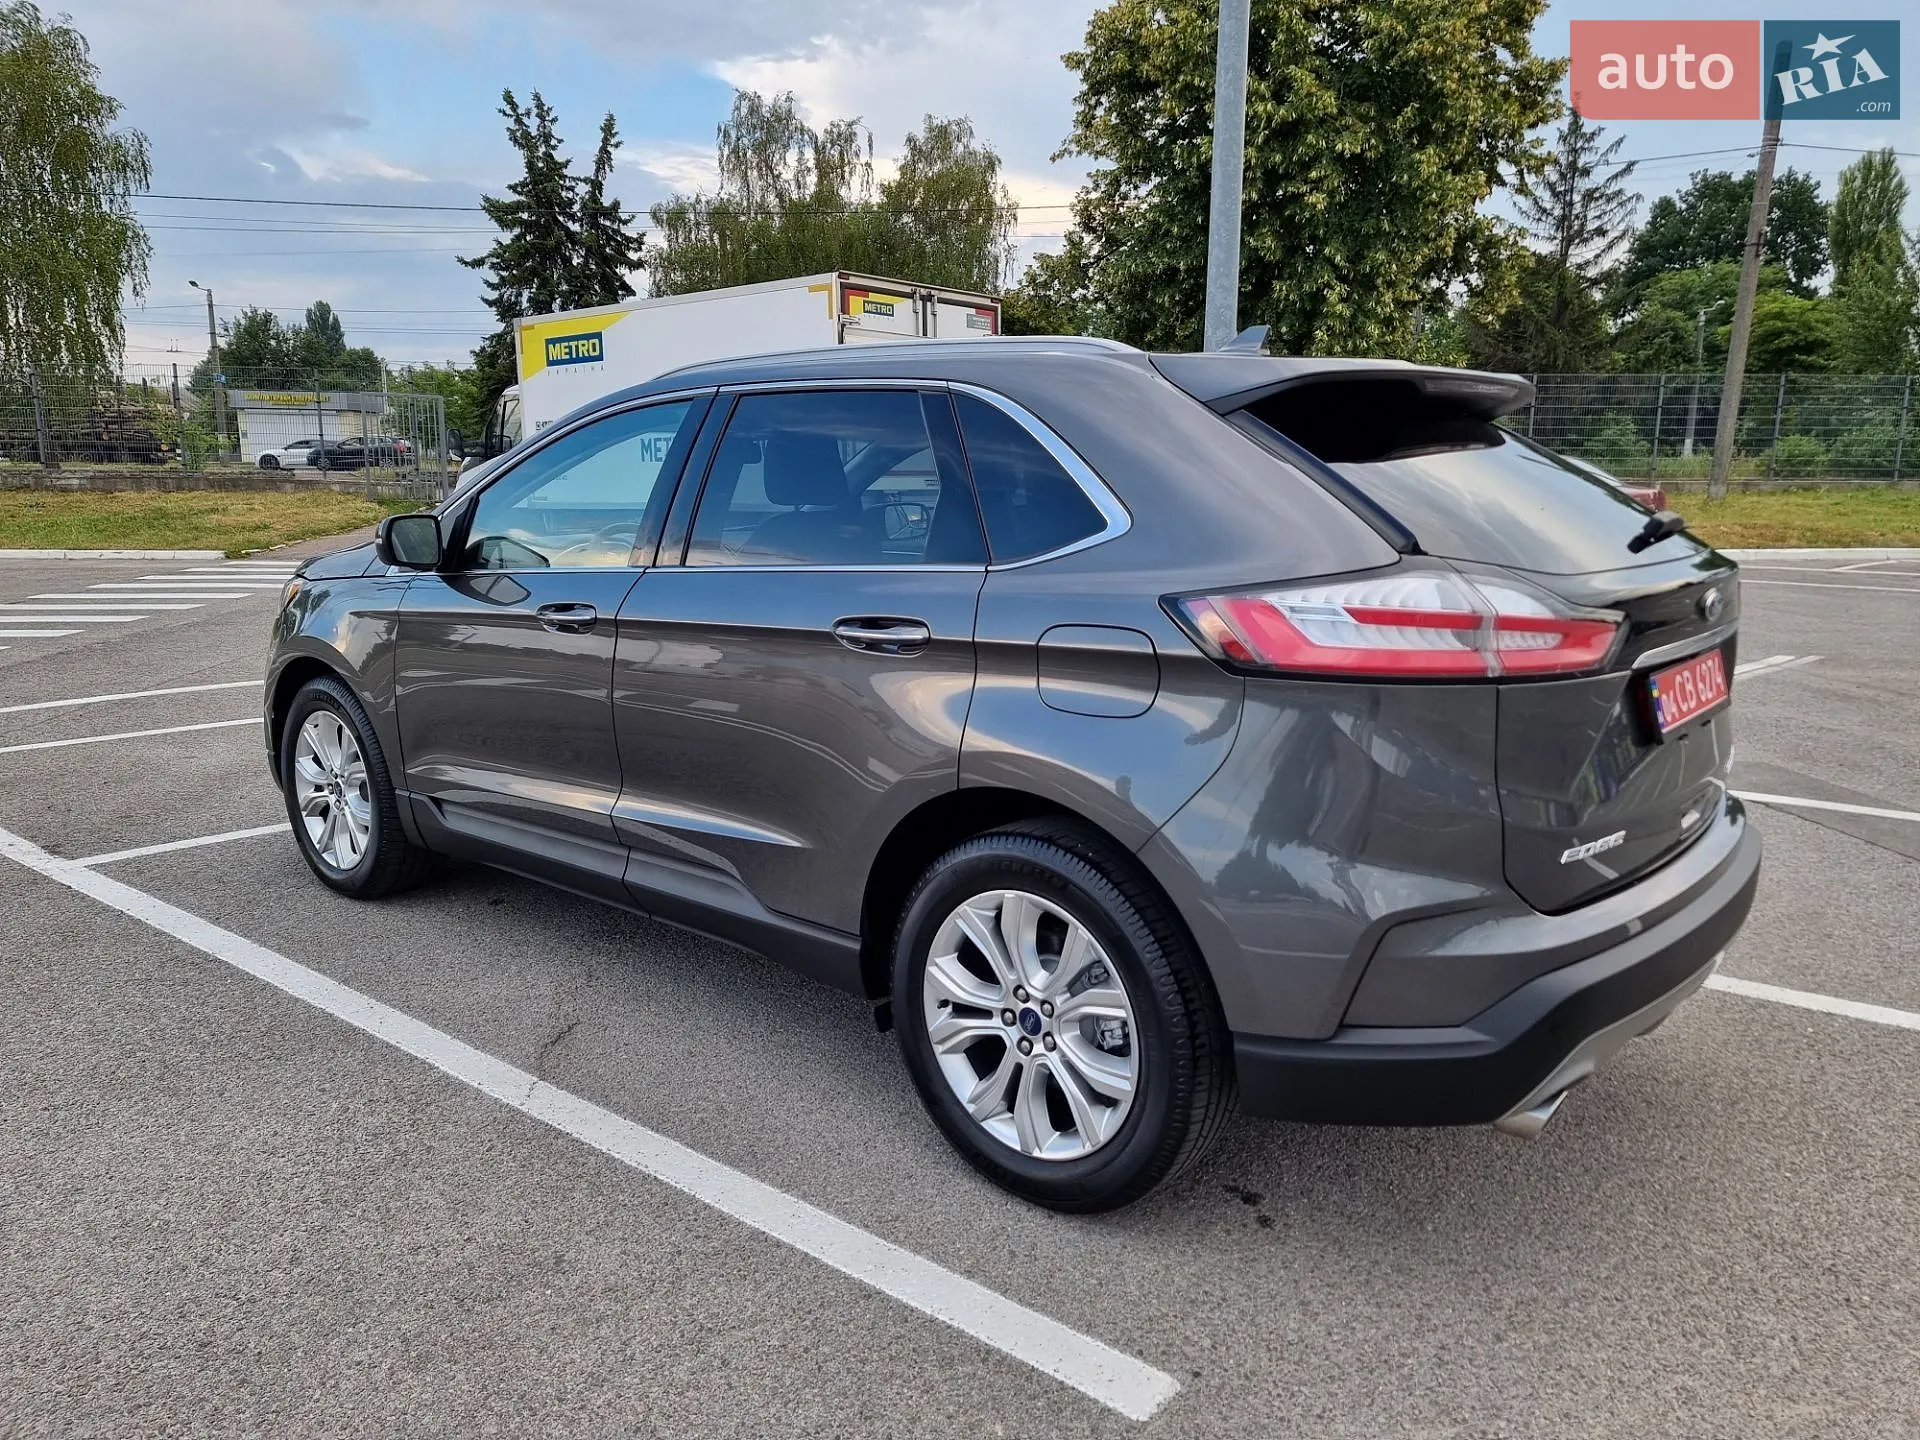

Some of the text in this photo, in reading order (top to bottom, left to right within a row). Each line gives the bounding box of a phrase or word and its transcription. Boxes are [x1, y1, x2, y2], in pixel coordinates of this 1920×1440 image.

[865, 303, 893, 314] METRO
[548, 339, 600, 361] METRO
[1675, 669, 1697, 712] CB
[1696, 657, 1725, 702] 6274
